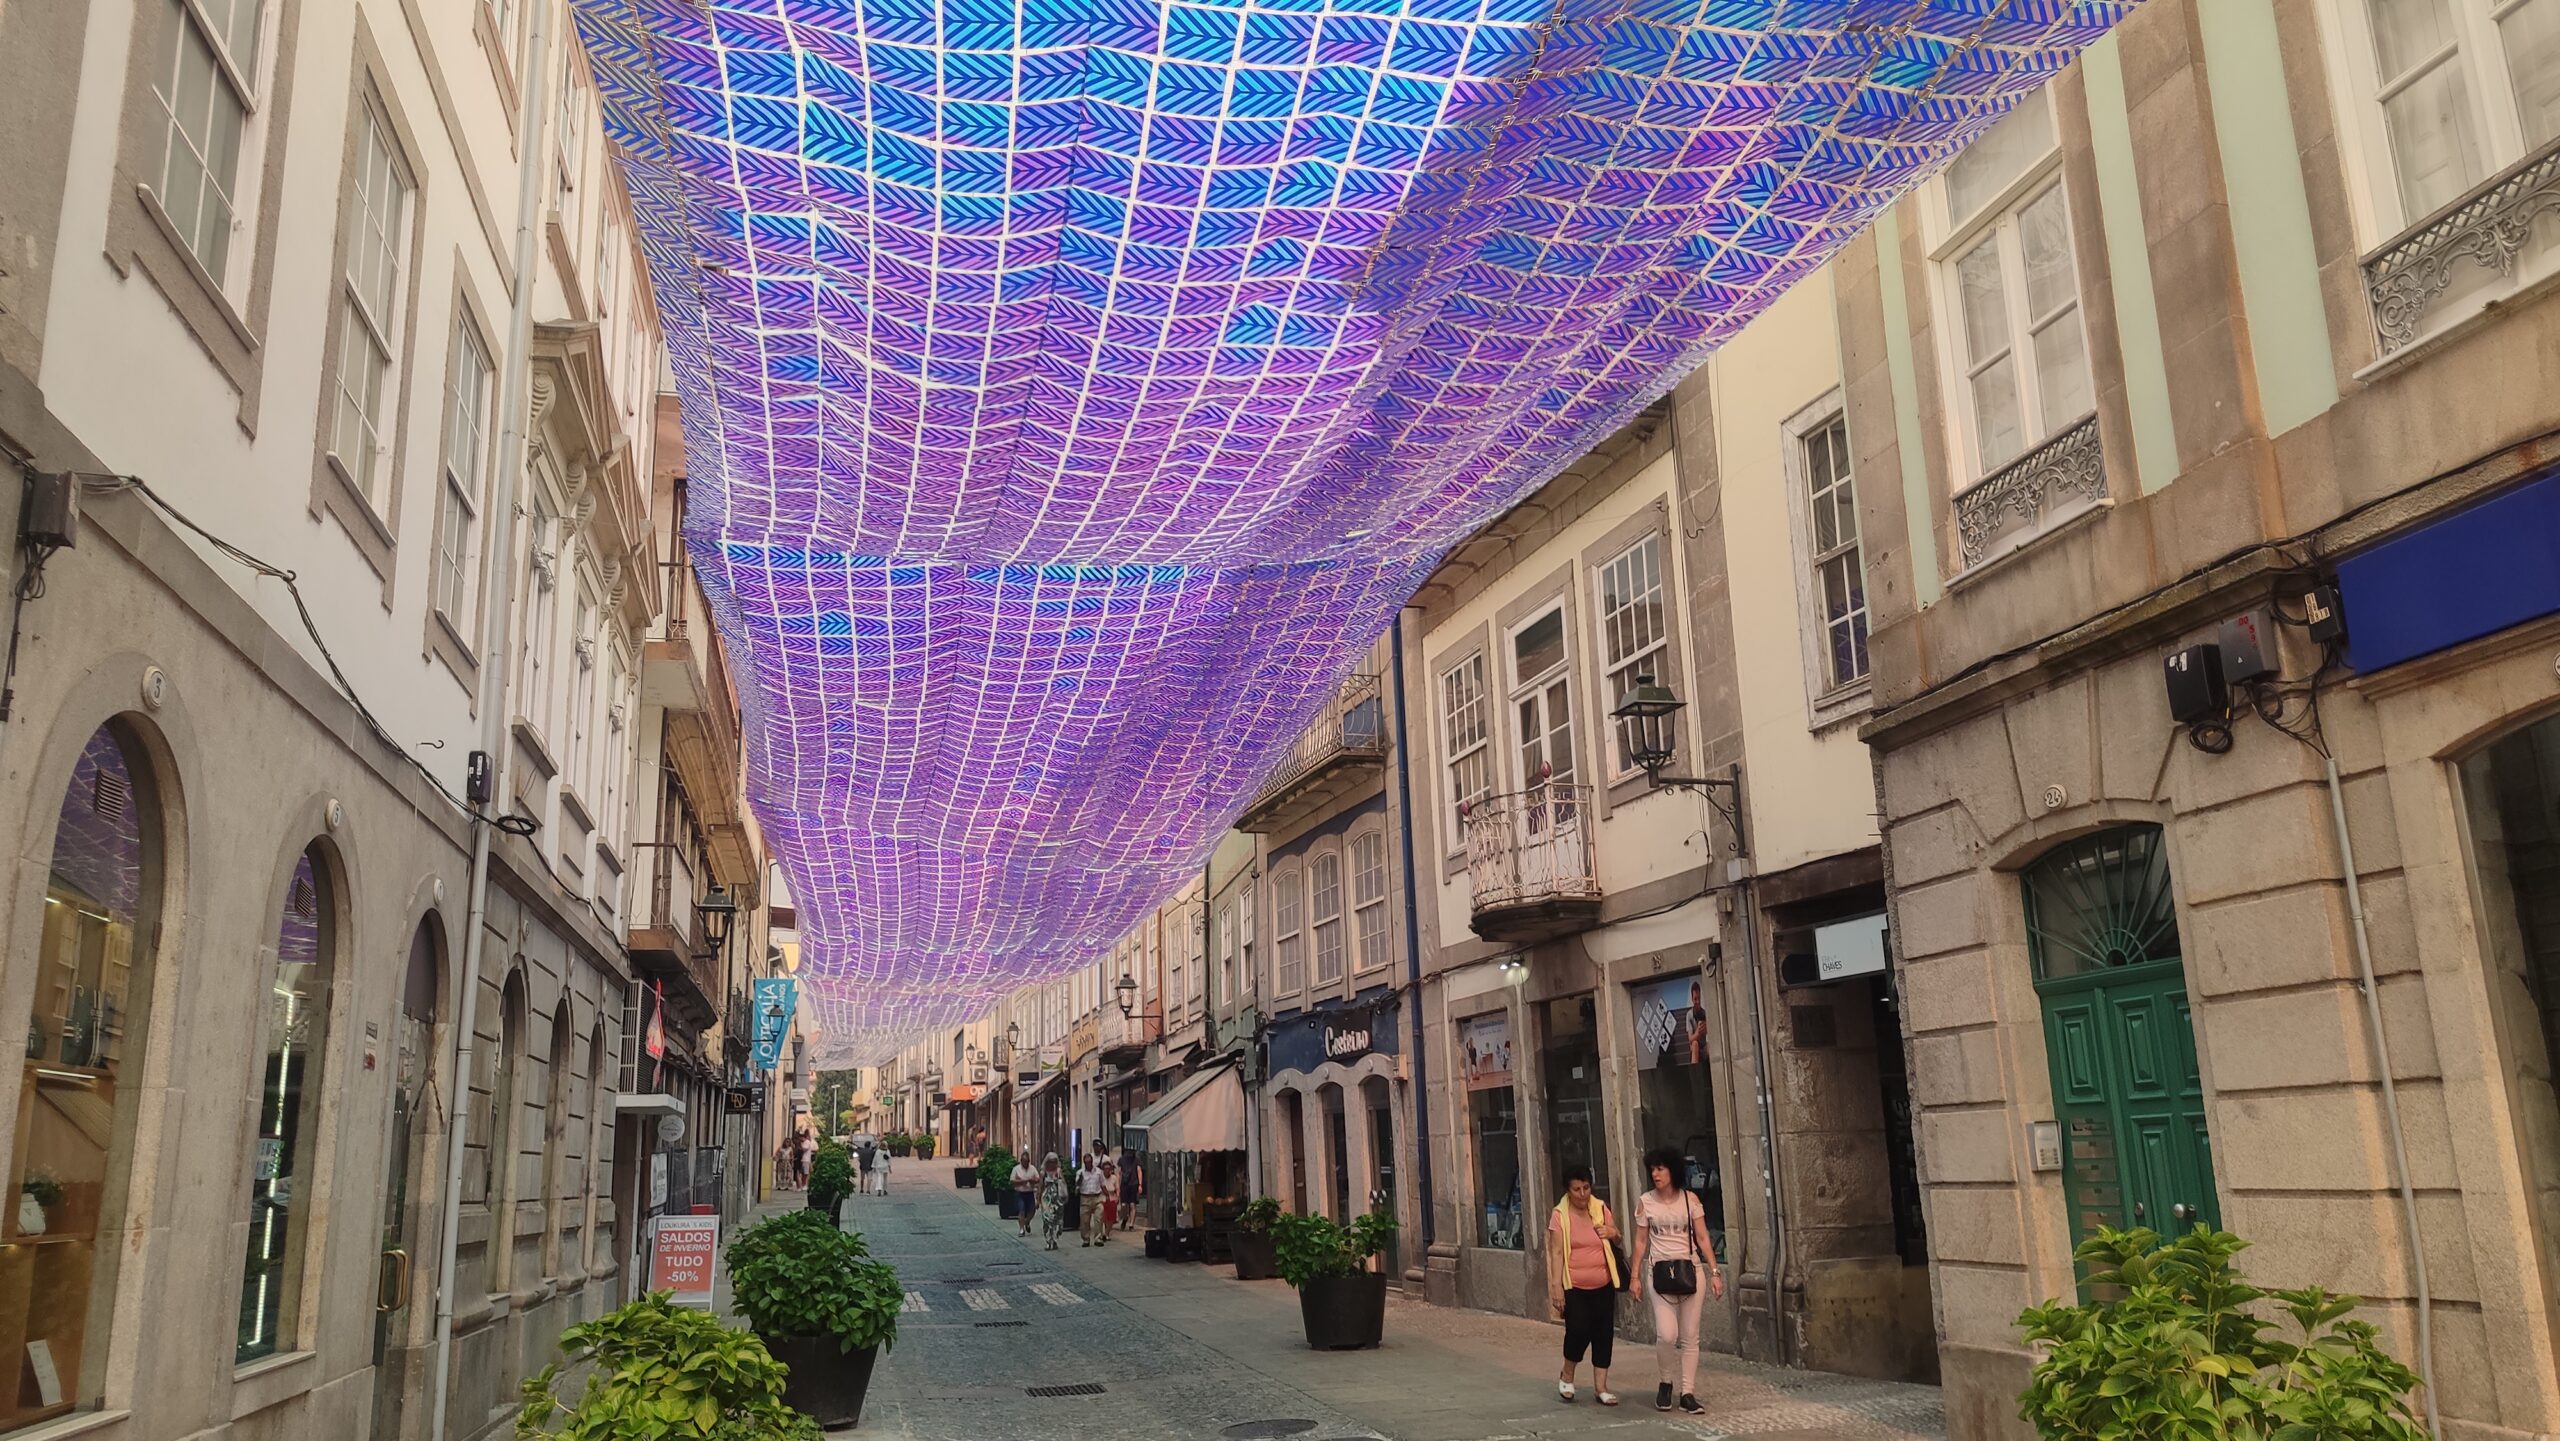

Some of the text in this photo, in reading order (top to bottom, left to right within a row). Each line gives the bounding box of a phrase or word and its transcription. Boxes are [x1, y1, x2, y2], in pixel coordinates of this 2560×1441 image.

[2046, 791, 2060, 805] 24
[1822, 961, 1843, 972] CHAVES
[661, 1232, 711, 1243] SALDOS
[674, 1244, 711, 1252] INVERNO
[665, 1256, 703, 1267] TUDO
[667, 1271, 699, 1282] -50%
